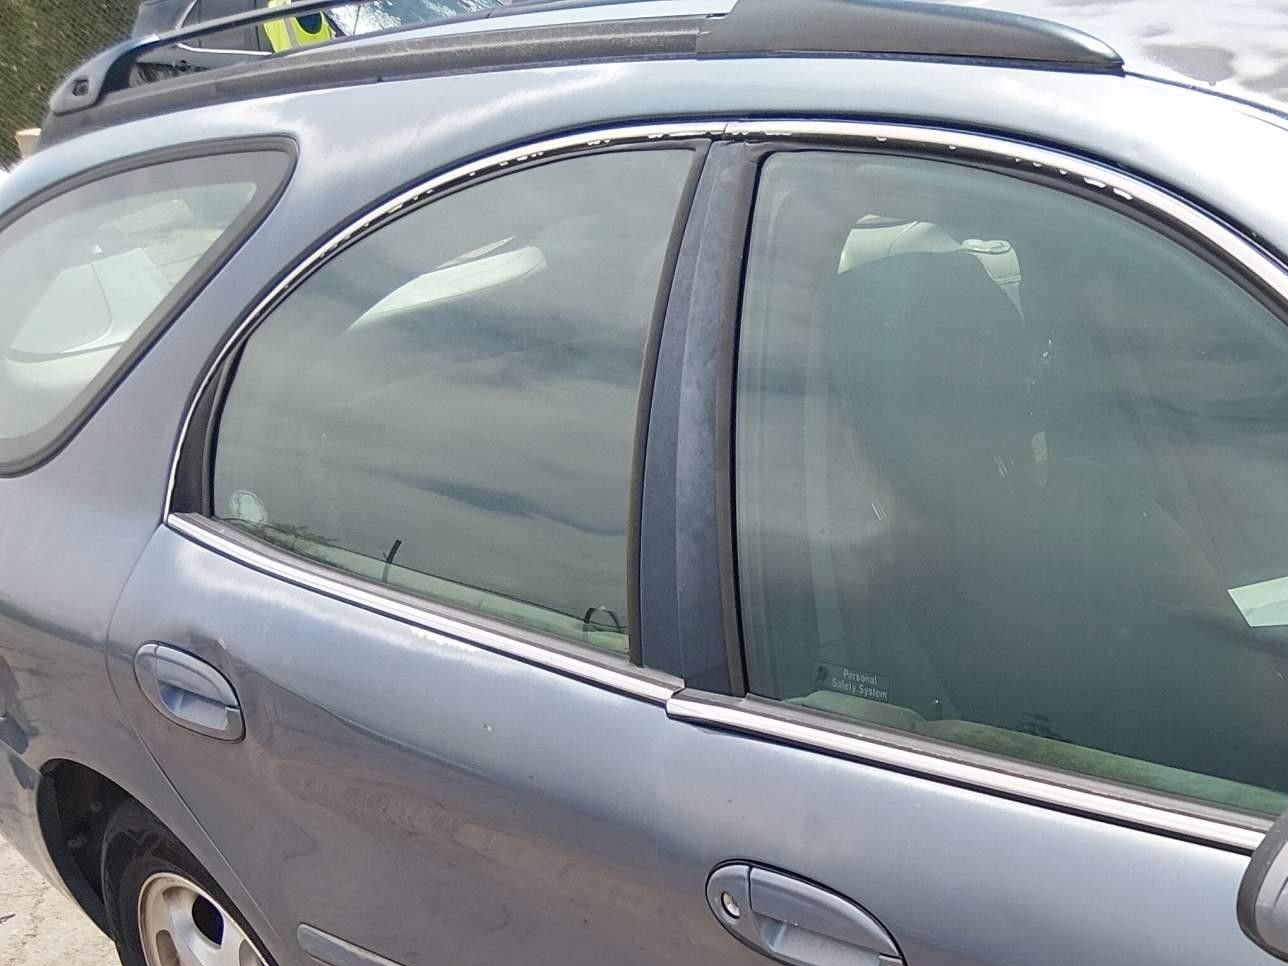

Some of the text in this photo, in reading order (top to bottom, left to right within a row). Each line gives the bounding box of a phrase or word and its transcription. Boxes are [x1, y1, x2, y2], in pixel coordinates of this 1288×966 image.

[843, 668, 877, 685] Personal
[832, 678, 887, 699] Safety System
